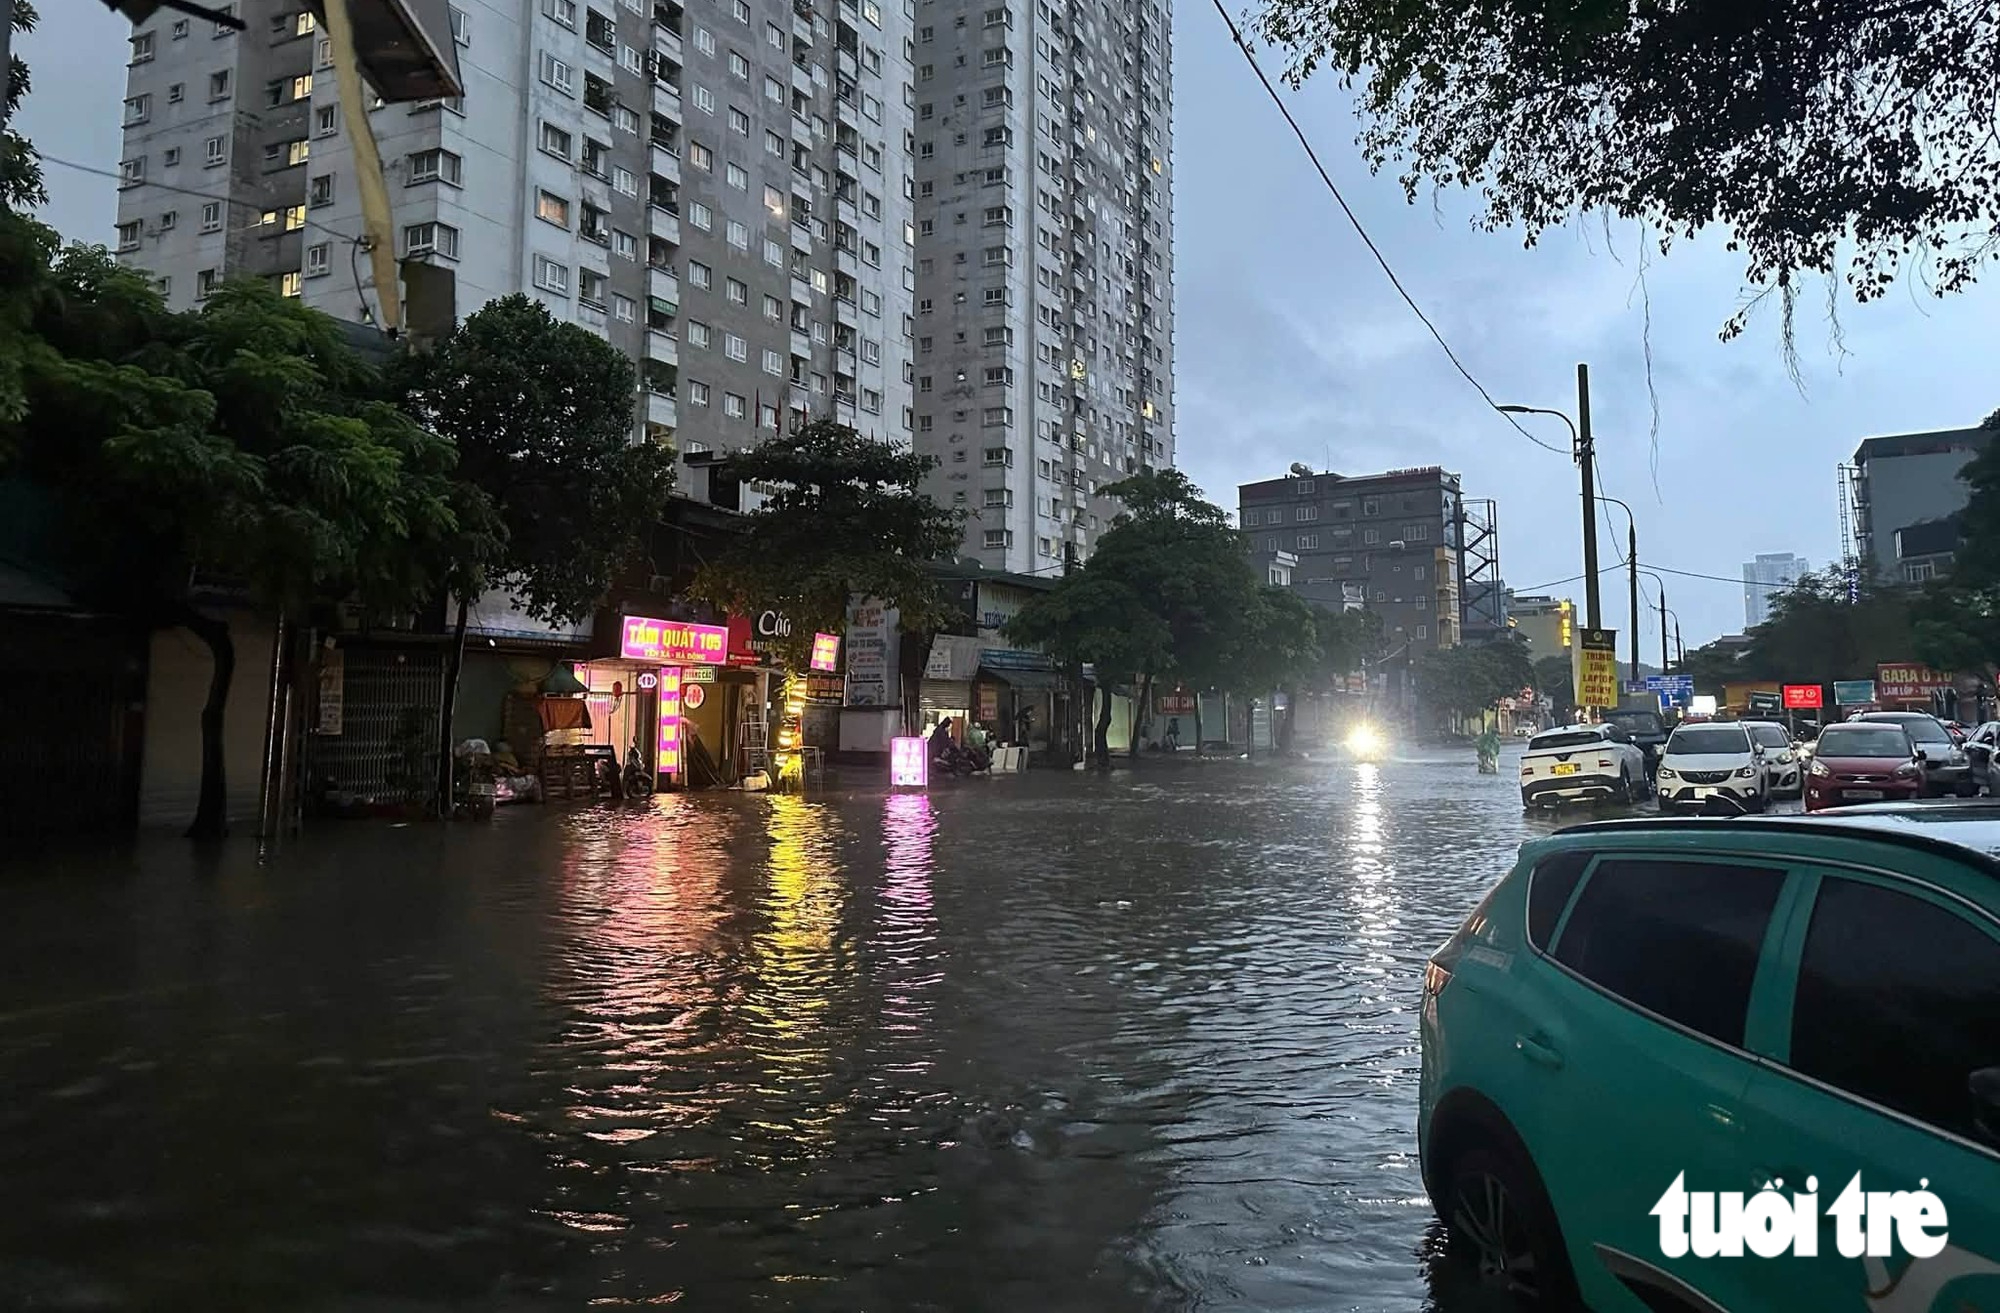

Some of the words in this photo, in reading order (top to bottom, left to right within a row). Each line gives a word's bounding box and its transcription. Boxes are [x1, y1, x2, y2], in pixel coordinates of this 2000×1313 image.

[662, 625, 696, 649] QUẤT
[698, 633, 722, 651] 105
[1582, 674, 1614, 684] LAPTOP
[1881, 669, 1919, 683] GARA
